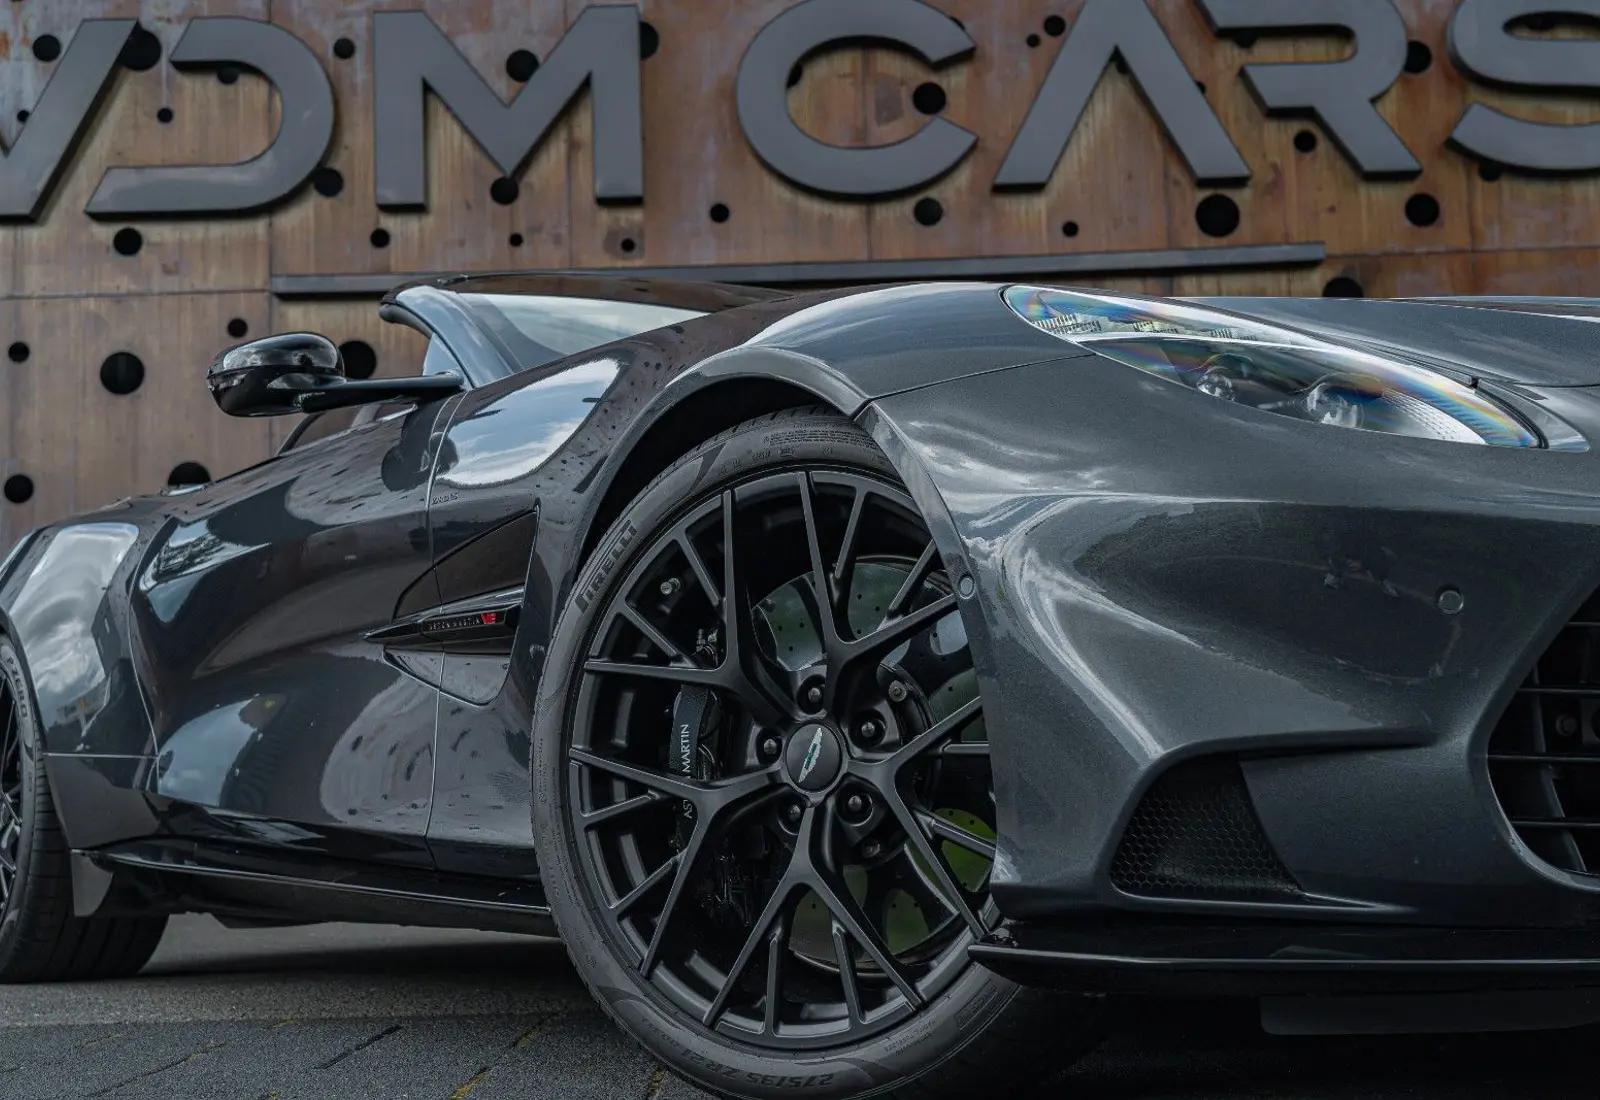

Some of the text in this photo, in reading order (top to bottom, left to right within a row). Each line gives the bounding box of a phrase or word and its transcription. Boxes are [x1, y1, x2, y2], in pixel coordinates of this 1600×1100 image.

[0, 0, 1600, 221] VDM CARS
[575, 519, 638, 614] PIRELLI
[680, 724, 692, 773] MARTIN
[746, 1072, 835, 1088] 275/35
